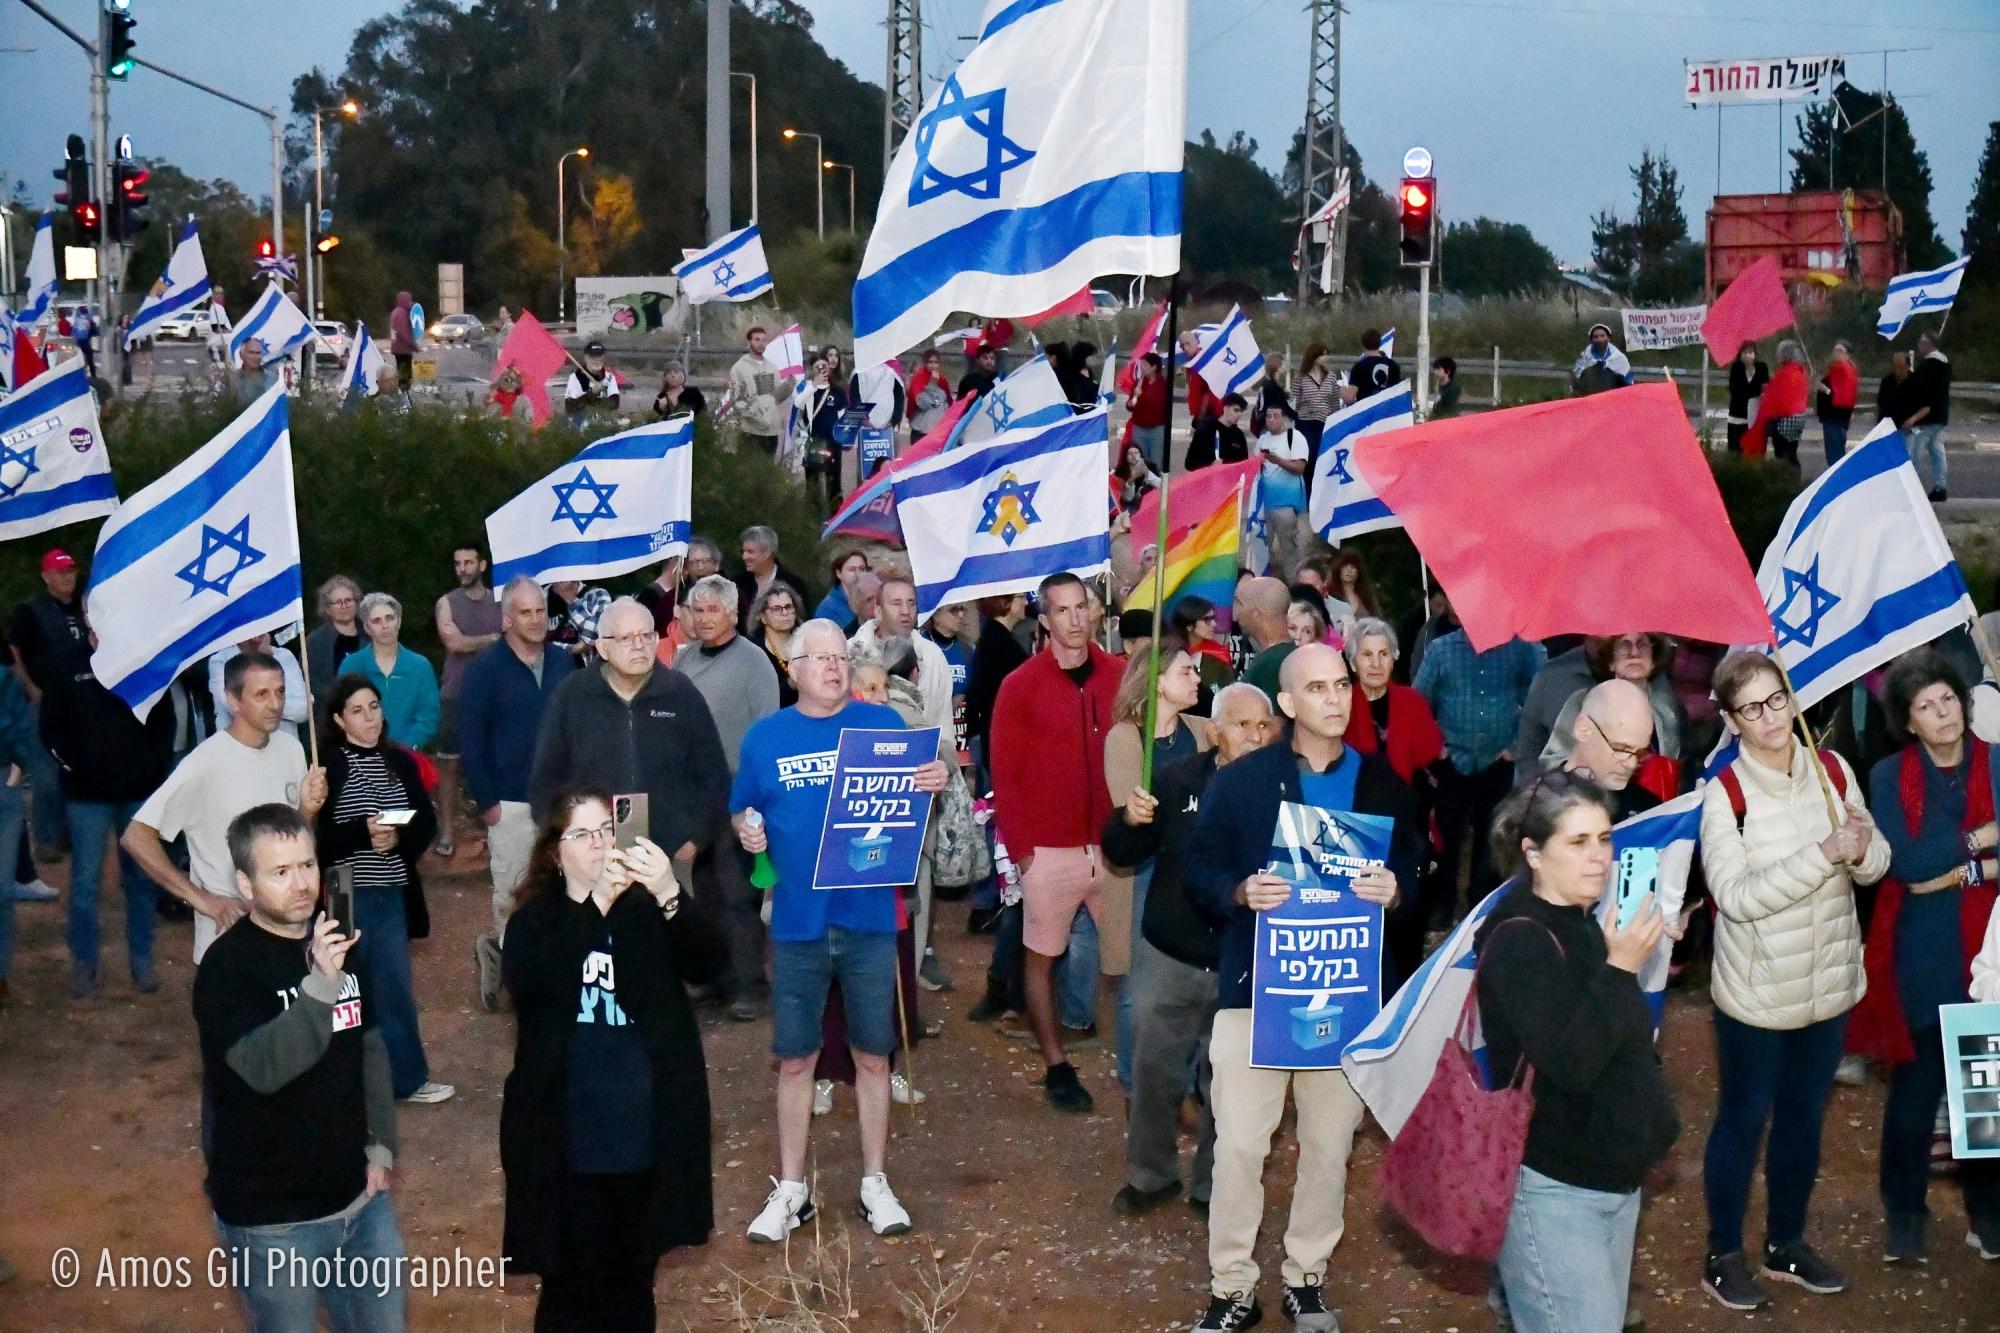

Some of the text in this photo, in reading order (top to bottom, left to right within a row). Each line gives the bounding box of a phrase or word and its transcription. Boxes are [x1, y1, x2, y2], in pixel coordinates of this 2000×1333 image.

[778, 757, 836, 776] קרטים
[786, 777, 829, 791] יאיר גולן
[848, 796, 911, 821] בקלפי
[1319, 852, 1368, 868] מוותרים
[1320, 864, 1361, 878] שראל!
[1269, 927, 1369, 956] נתחשבן
[1280, 955, 1359, 987] בקלפי
